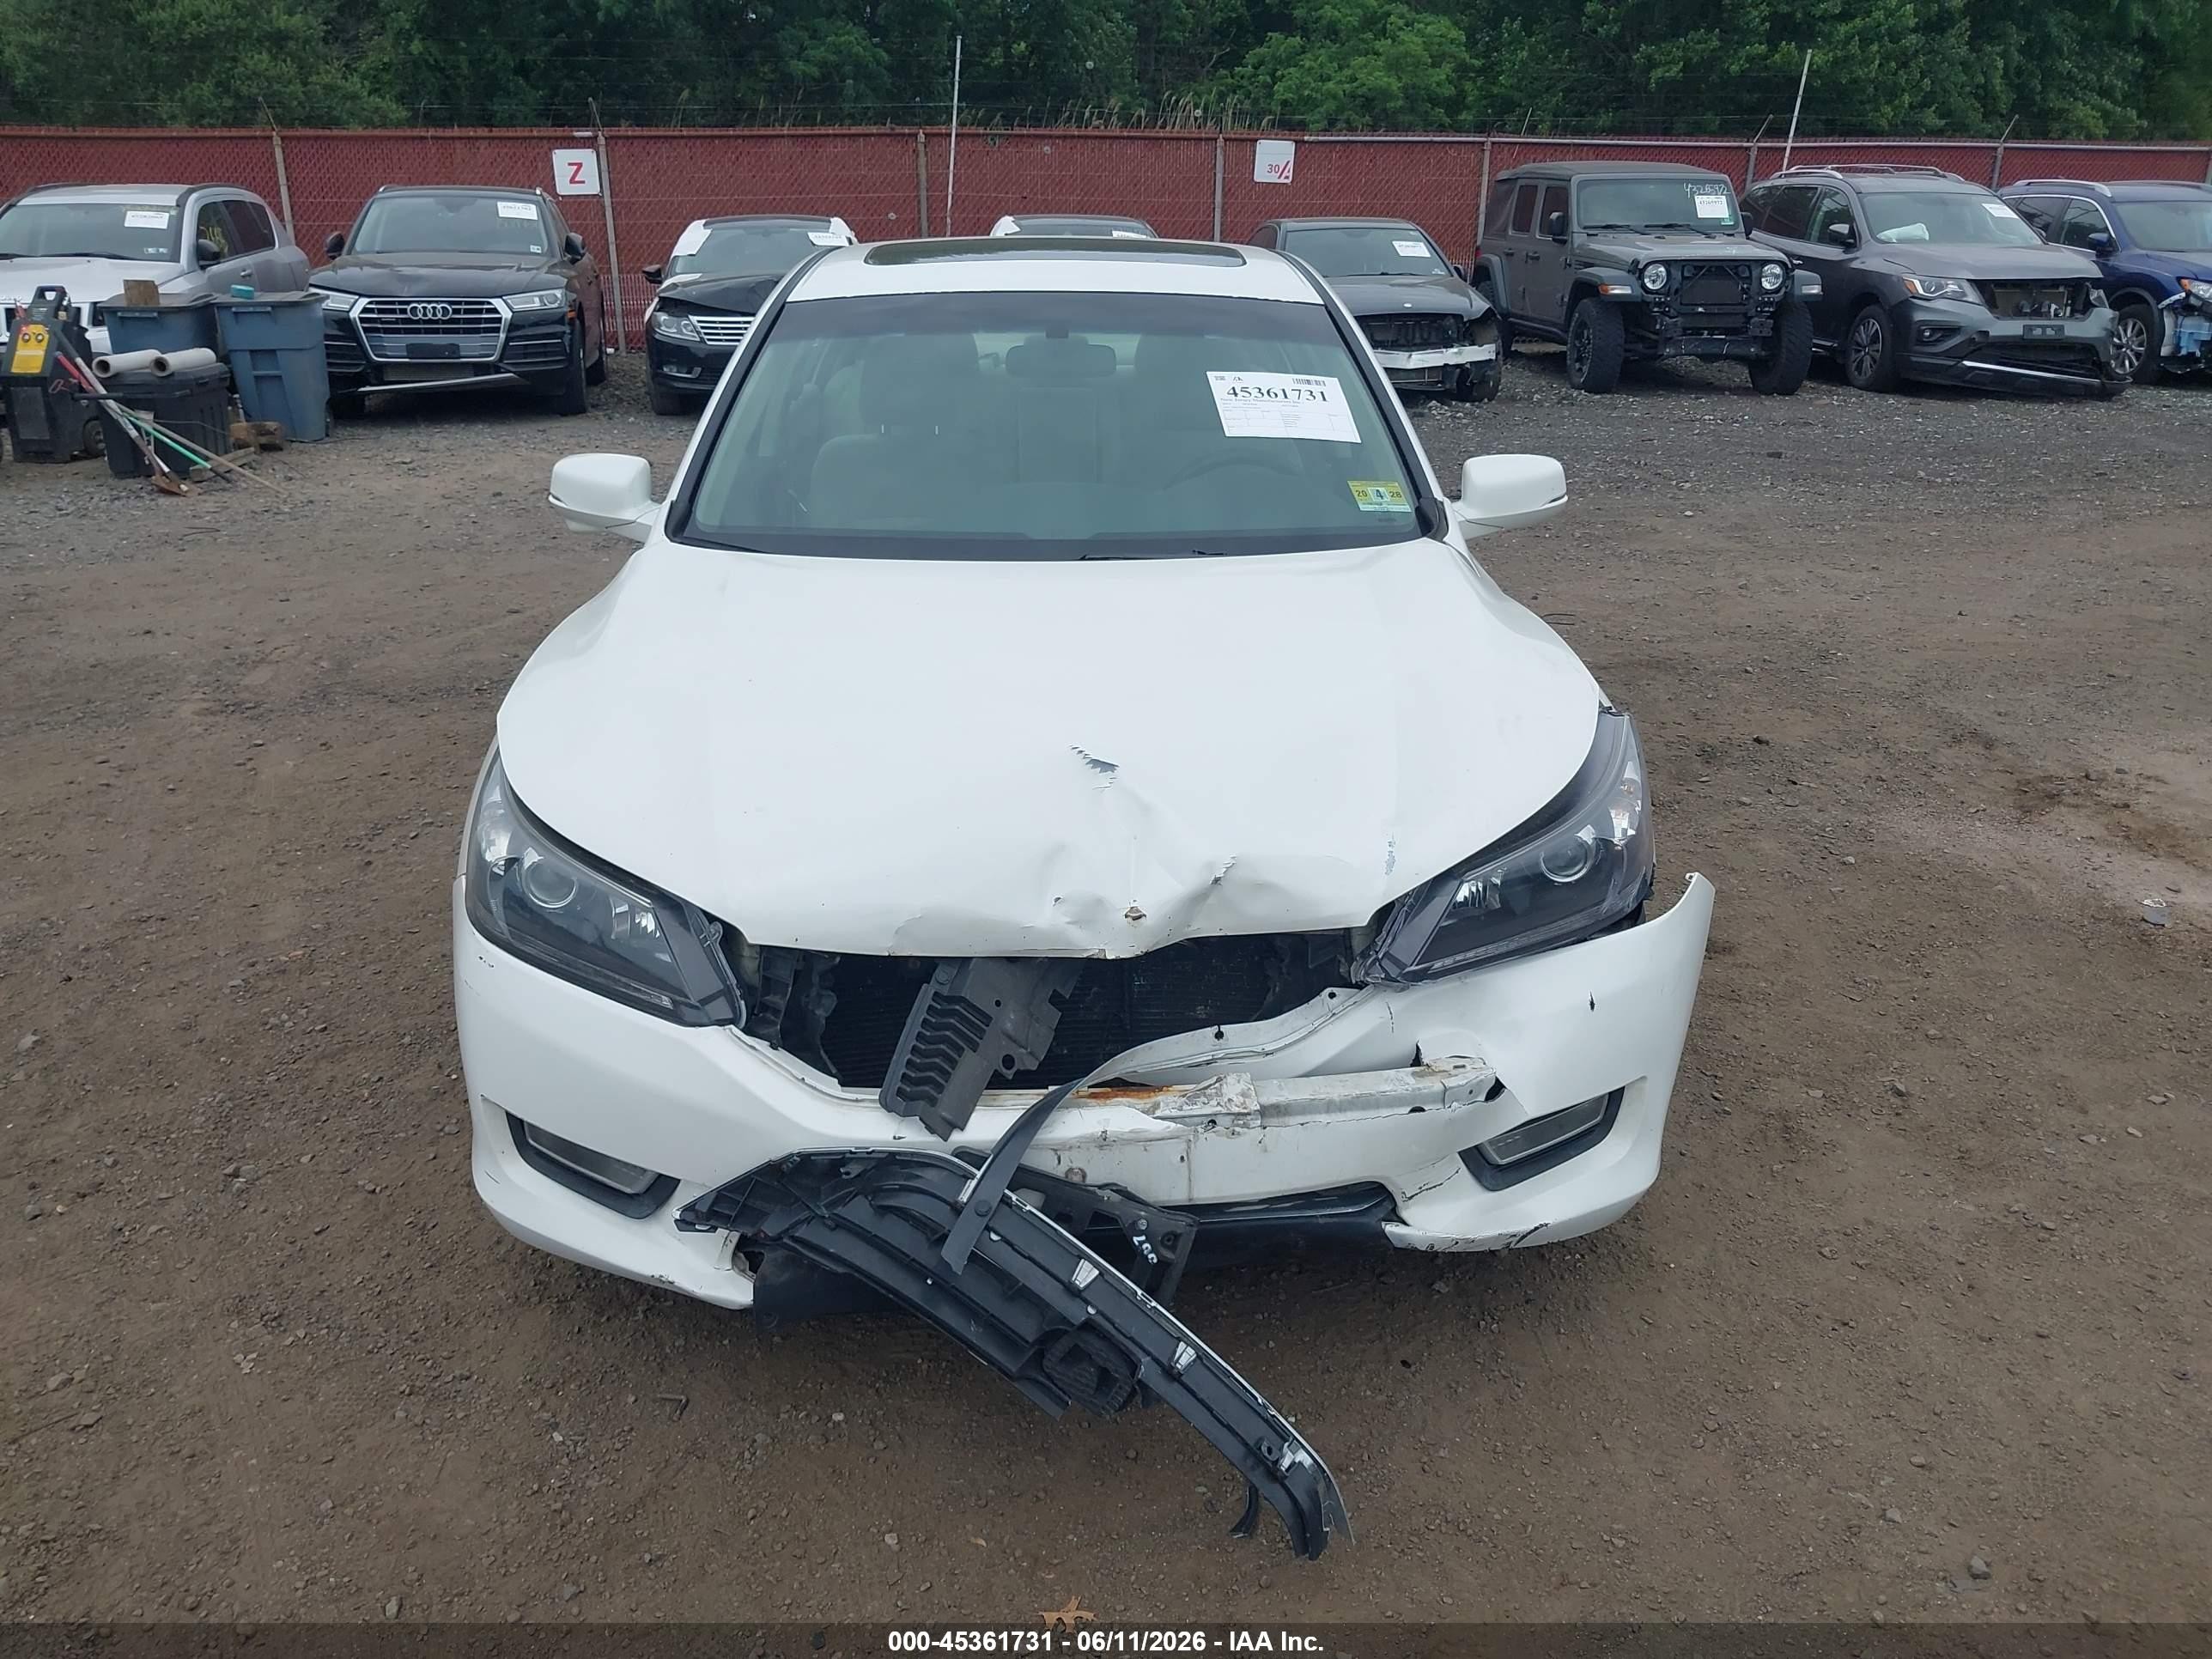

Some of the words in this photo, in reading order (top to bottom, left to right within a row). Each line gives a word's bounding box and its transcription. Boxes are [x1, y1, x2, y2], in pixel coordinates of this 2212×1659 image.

[568, 161, 586, 185] Z
[1226, 386, 1329, 403] 45361731
[1355, 489, 1368, 498] 20
[1375, 489, 1384, 501] 4
[1389, 490, 1402, 499] 28
